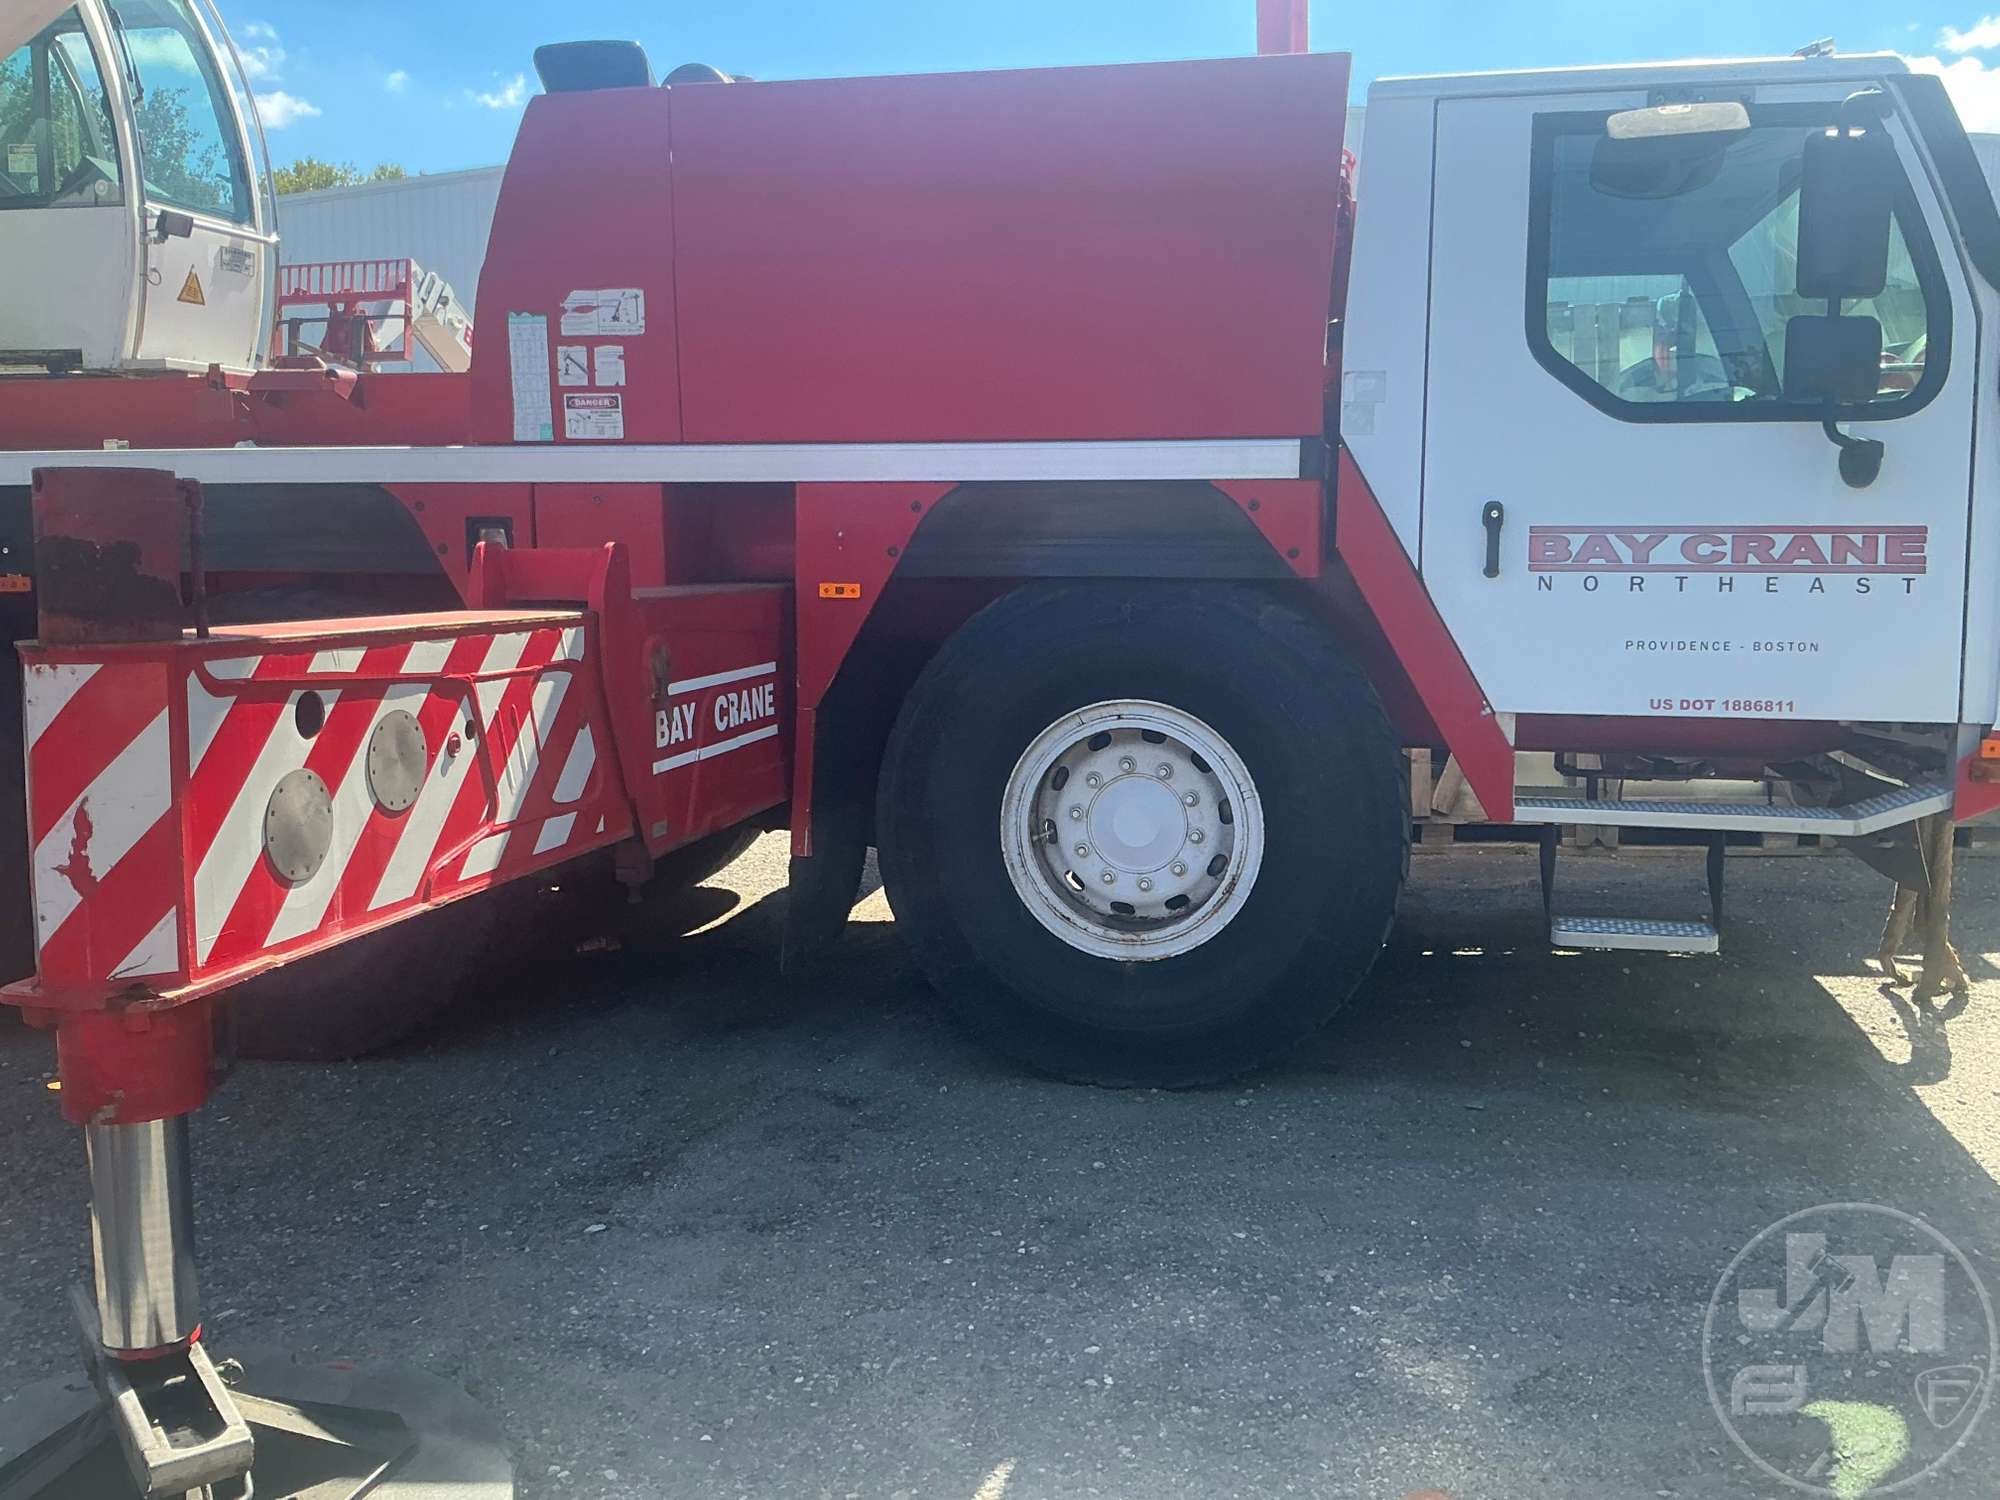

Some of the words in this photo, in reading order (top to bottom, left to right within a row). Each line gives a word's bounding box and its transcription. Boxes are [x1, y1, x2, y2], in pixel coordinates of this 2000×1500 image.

[1528, 534, 1668, 564] BAY
[1680, 534, 1927, 565] CRANE
[1537, 575, 1916, 595] NORTHEAST
[1625, 640, 1732, 652] PROVIDENCE
[1752, 641, 1820, 653] BOSTON
[655, 702, 696, 748] BAY
[714, 683, 775, 731] CRANE
[1649, 698, 1674, 711] US
[1679, 699, 1716, 712] DOT
[1721, 700, 1796, 713] 1886811
